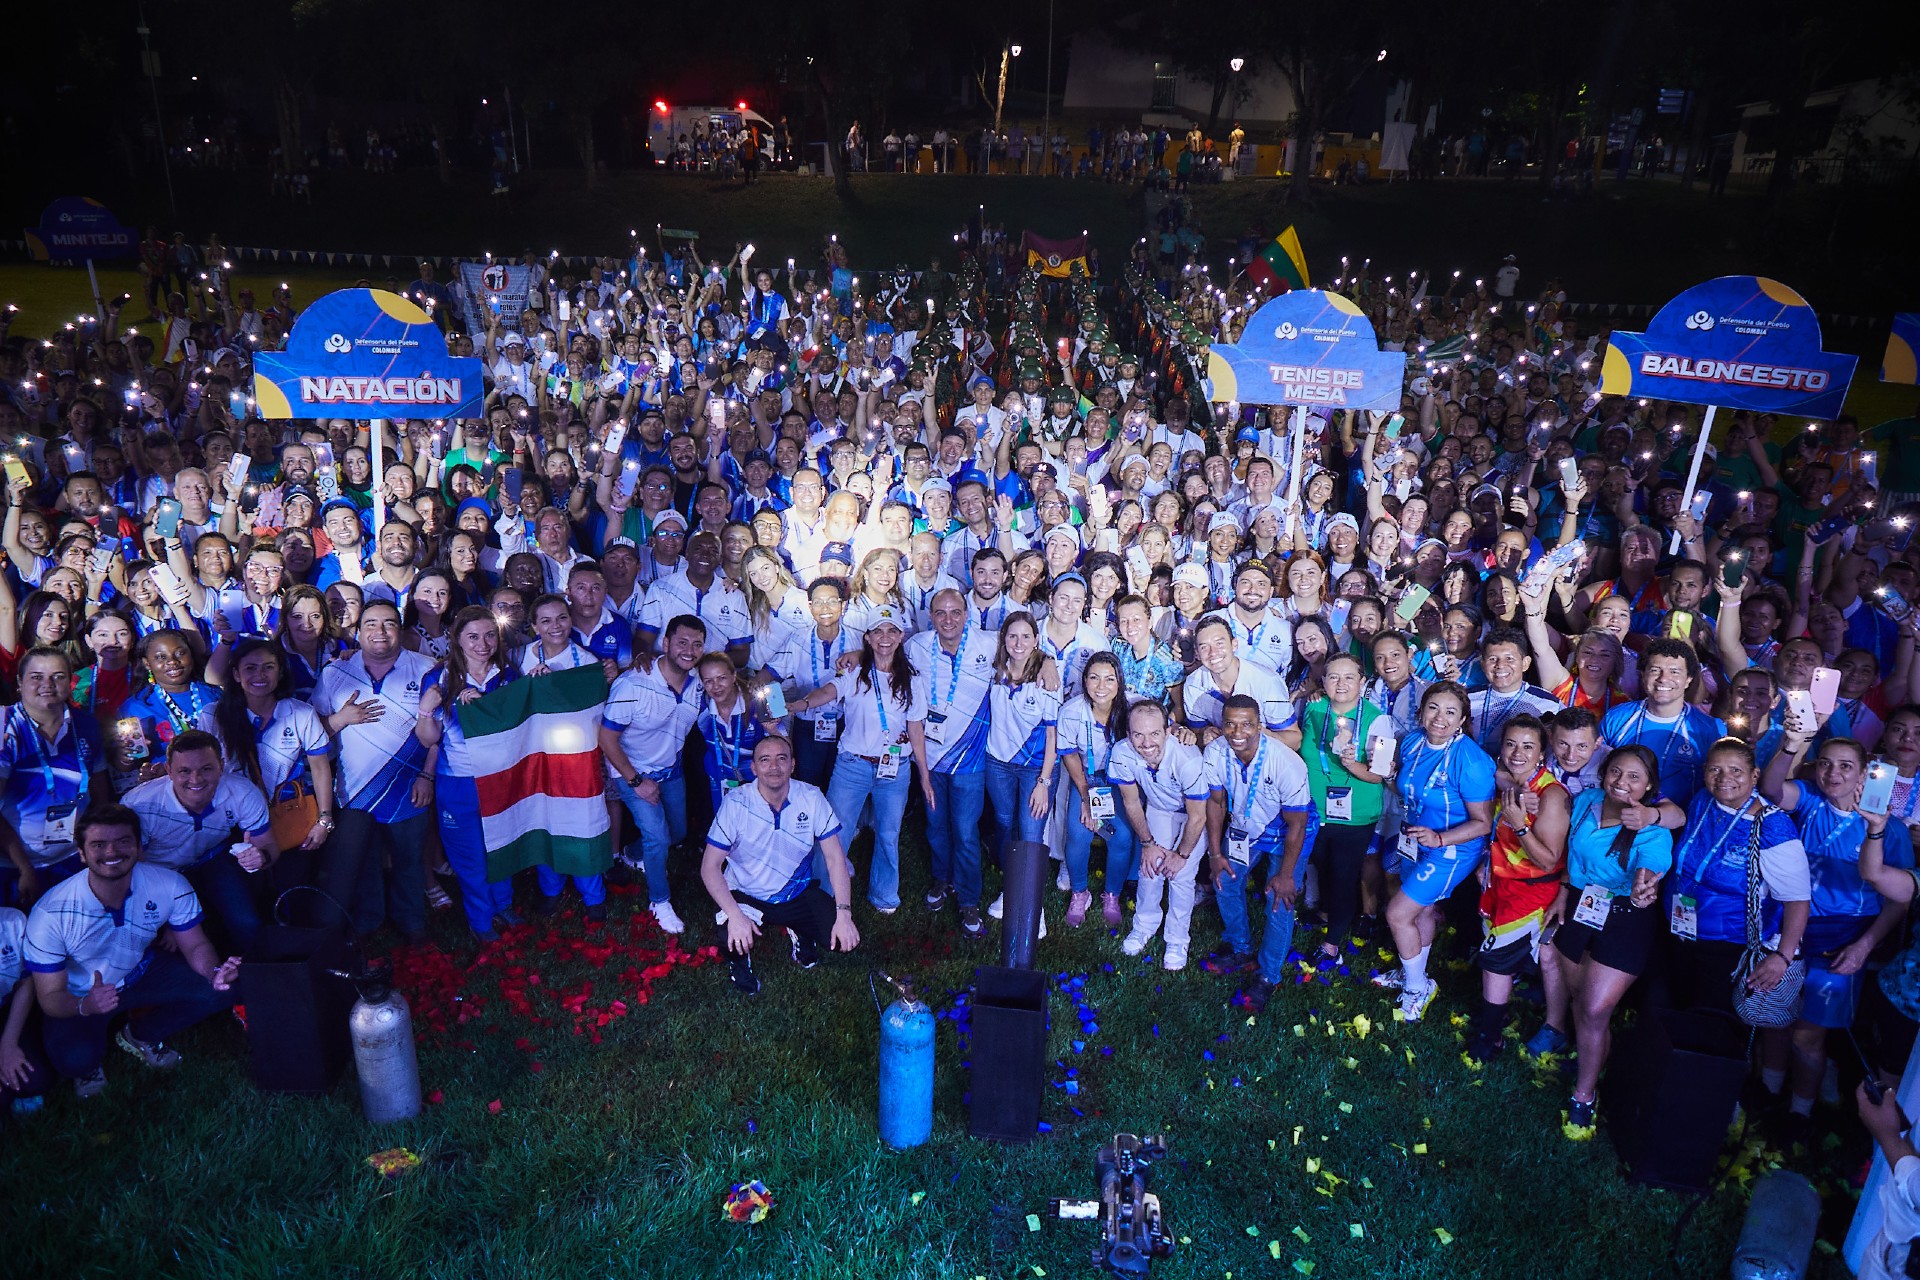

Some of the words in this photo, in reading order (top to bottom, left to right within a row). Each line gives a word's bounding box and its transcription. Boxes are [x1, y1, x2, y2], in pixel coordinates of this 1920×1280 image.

[1338, 329, 1357, 337] Pueblo
[1735, 326, 1767, 336] COLOMBIA
[1767, 321, 1791, 329] Pueblo
[1313, 335, 1340, 343] COLOMBIA
[371, 347, 402, 355] COLOMBIA
[1269, 365, 1331, 385] TENIS
[1333, 370, 1362, 386] DE
[1641, 354, 1829, 390] BALONCESTO
[301, 371, 461, 402] NATACIÓN
[1284, 384, 1346, 403] MESA
[1416, 862, 1436, 881] 3
[1817, 981, 1832, 1005] 4
